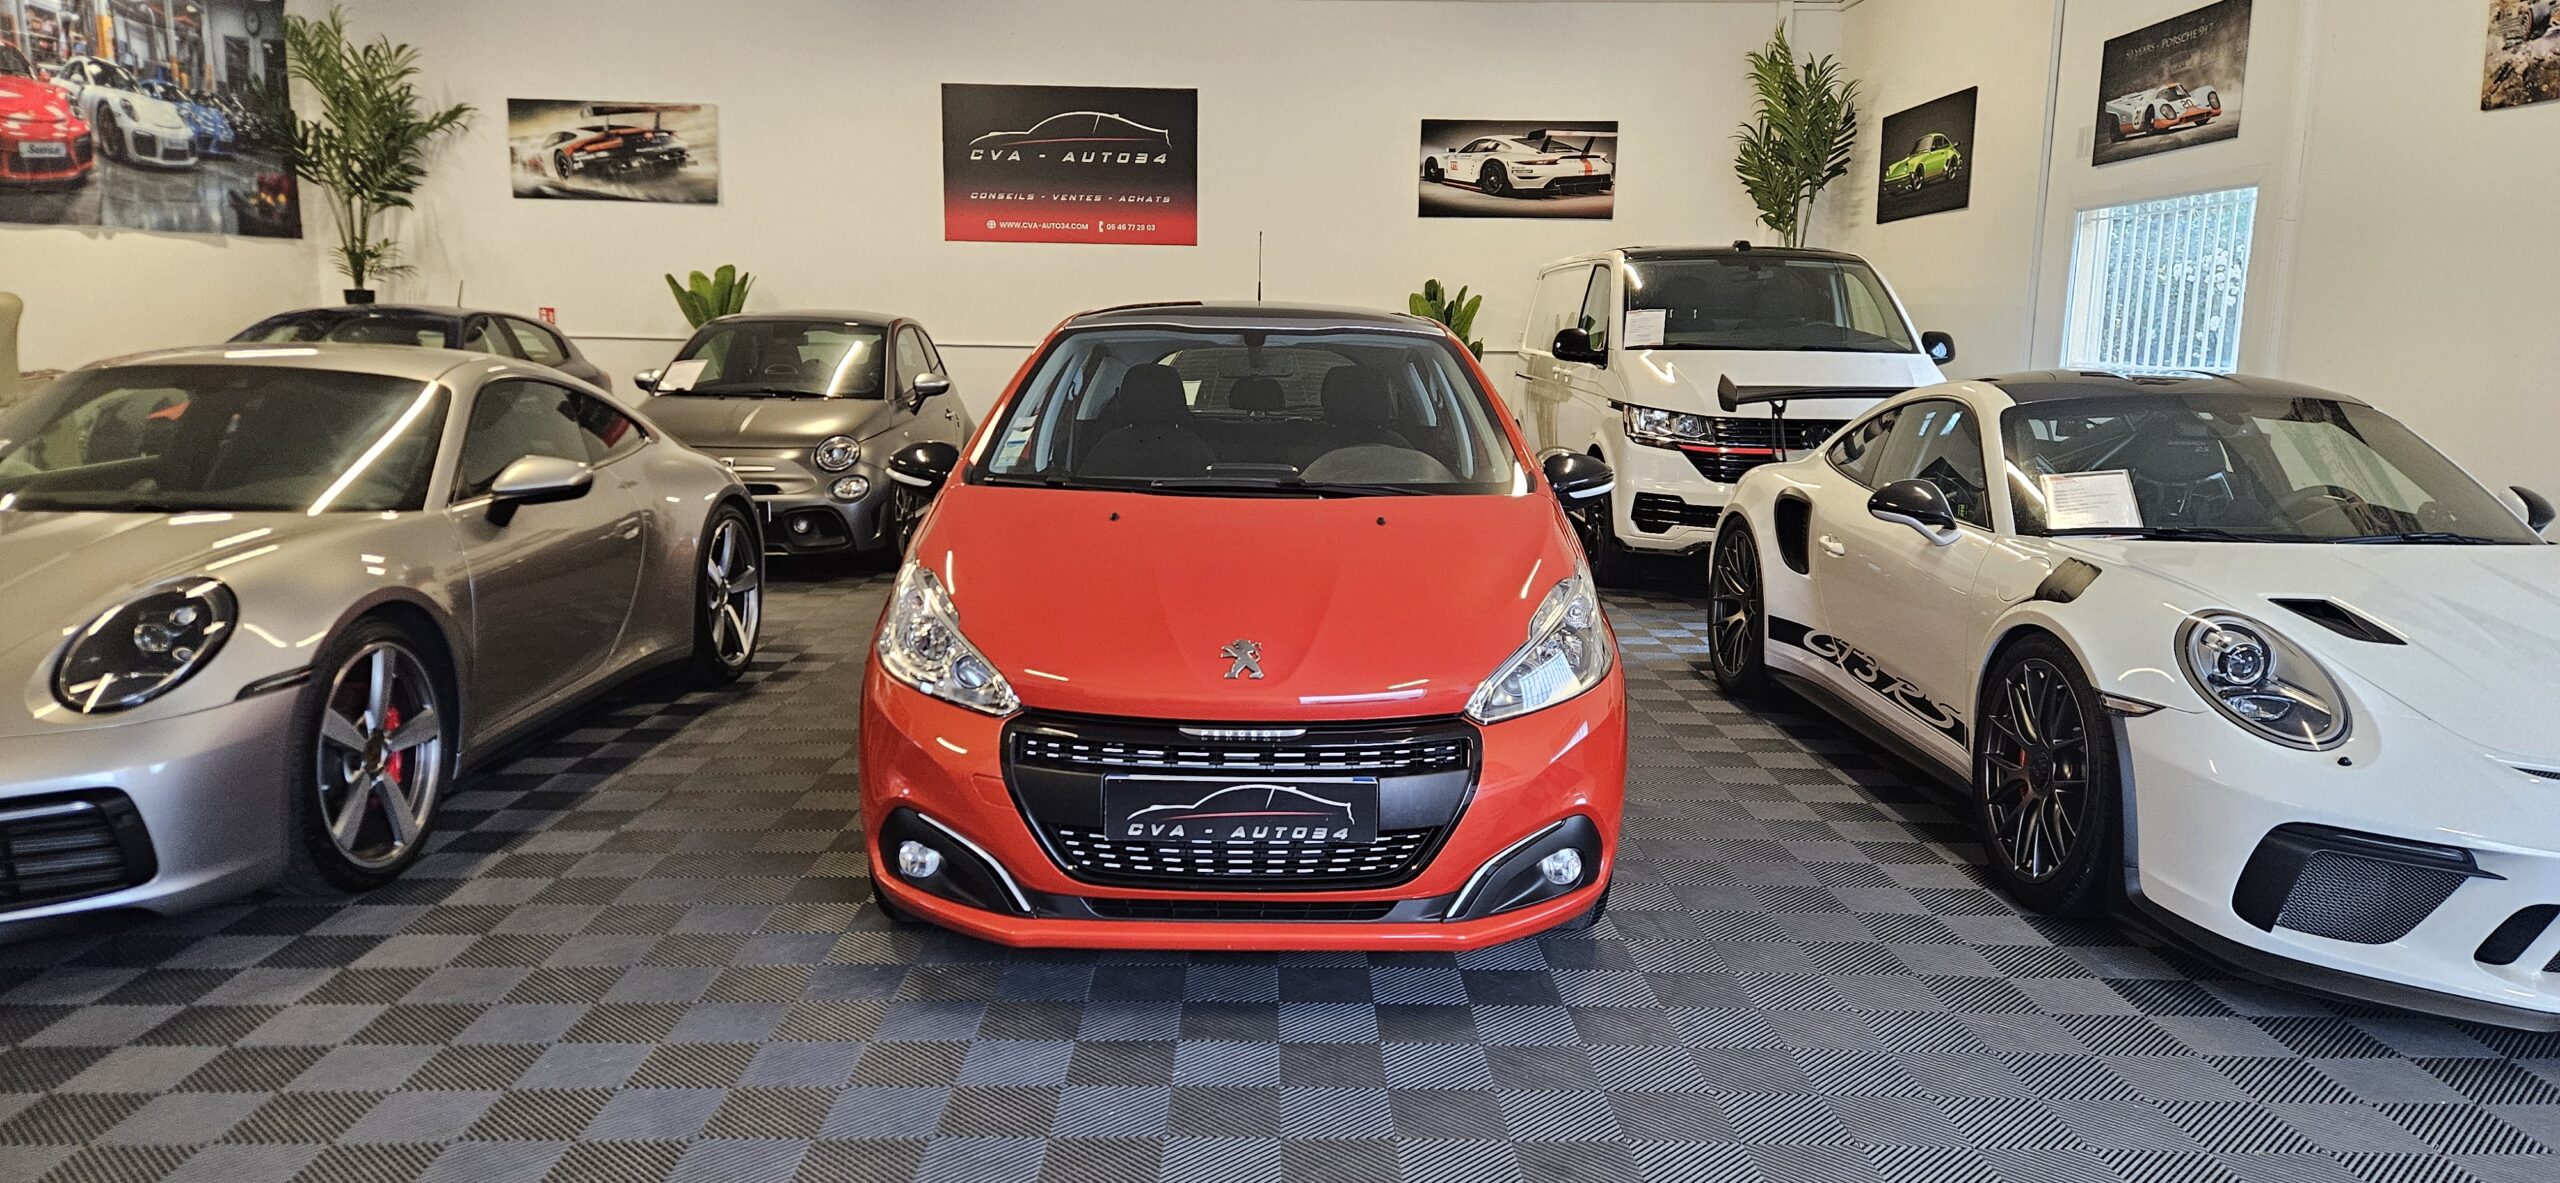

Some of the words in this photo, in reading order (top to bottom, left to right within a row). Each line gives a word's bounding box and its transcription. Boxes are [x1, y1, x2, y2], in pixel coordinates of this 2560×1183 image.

[2161, 29, 2198, 48] PORSCHE
[2199, 22, 2214, 36] 917
[2181, 99, 2194, 108] 20
[970, 149, 1021, 161] CVA
[1062, 151, 1167, 164] AUTO34
[970, 192, 1035, 200] CONSEILS
[1052, 194, 1102, 202] VENTES
[1118, 195, 1171, 203] ACHATS
[999, 221, 1089, 230] WWW.CVA-AUTO34.COM
[1127, 223, 1136, 231] 77
[1803, 629, 1881, 683] GT3
[1881, 675, 1961, 729] RS
[1200, 729, 1282, 739] PEUGEOT
[1127, 823, 1185, 837] CVA
[1230, 826, 1349, 840] AUTO34
